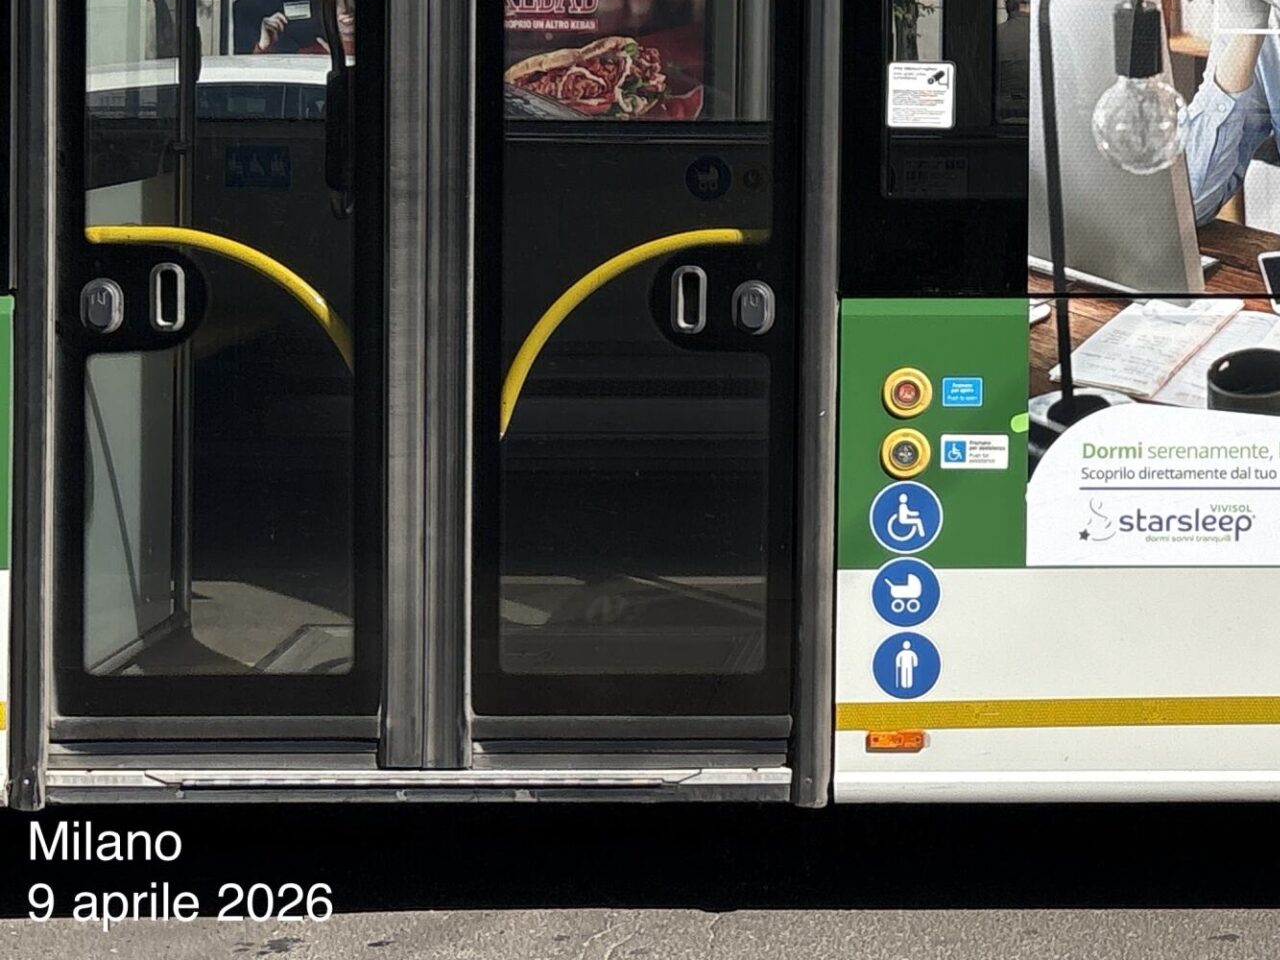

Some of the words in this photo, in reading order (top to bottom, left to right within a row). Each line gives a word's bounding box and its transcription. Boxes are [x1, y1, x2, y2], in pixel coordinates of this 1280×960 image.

[1082, 442, 1142, 459] Dormi
[1147, 444, 1274, 462] serenamente,
[1081, 467, 1136, 483] Scoprilo
[1139, 467, 1227, 480] direttamente
[1231, 467, 1251, 480] dal
[1254, 469, 1277, 480] tuo
[1210, 504, 1253, 513] VIVISOL
[1119, 508, 1252, 542] starsleep
